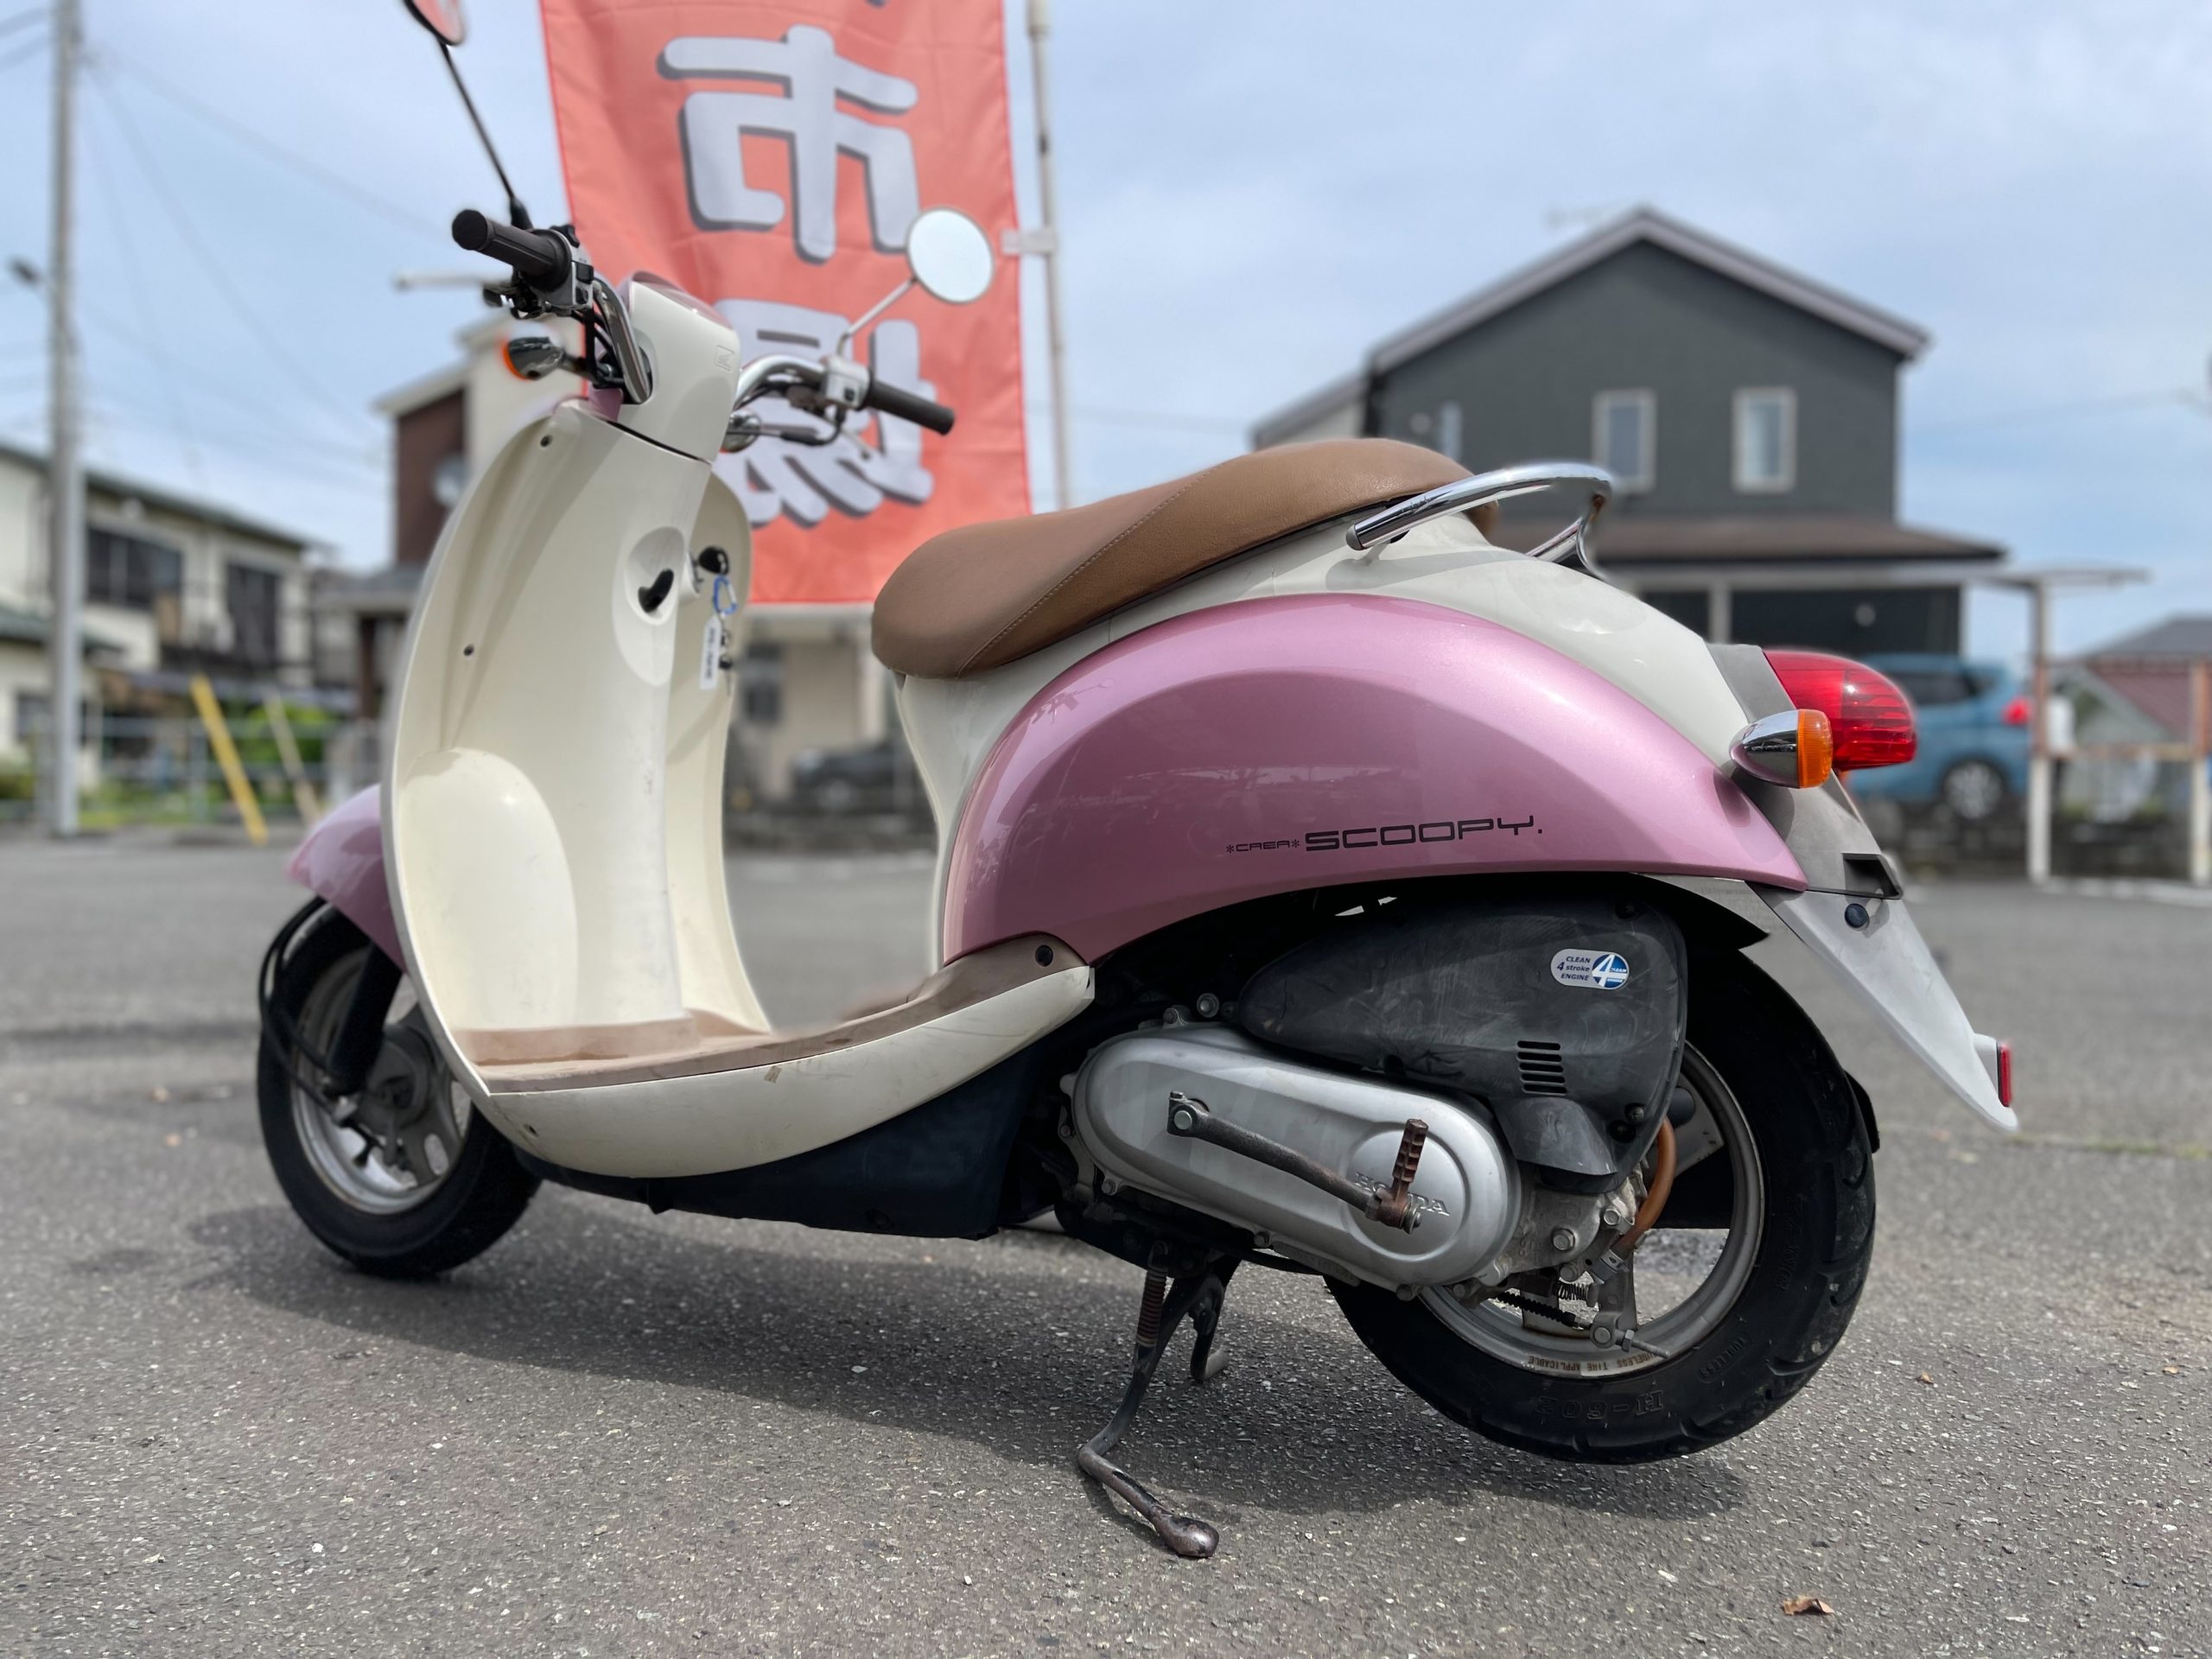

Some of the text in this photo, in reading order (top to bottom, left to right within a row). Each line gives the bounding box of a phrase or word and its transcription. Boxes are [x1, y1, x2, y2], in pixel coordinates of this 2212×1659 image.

[1557, 962, 1565, 971] 4
[1528, 1352, 1655, 1371] UBELESS TIRE APPLICABLE
